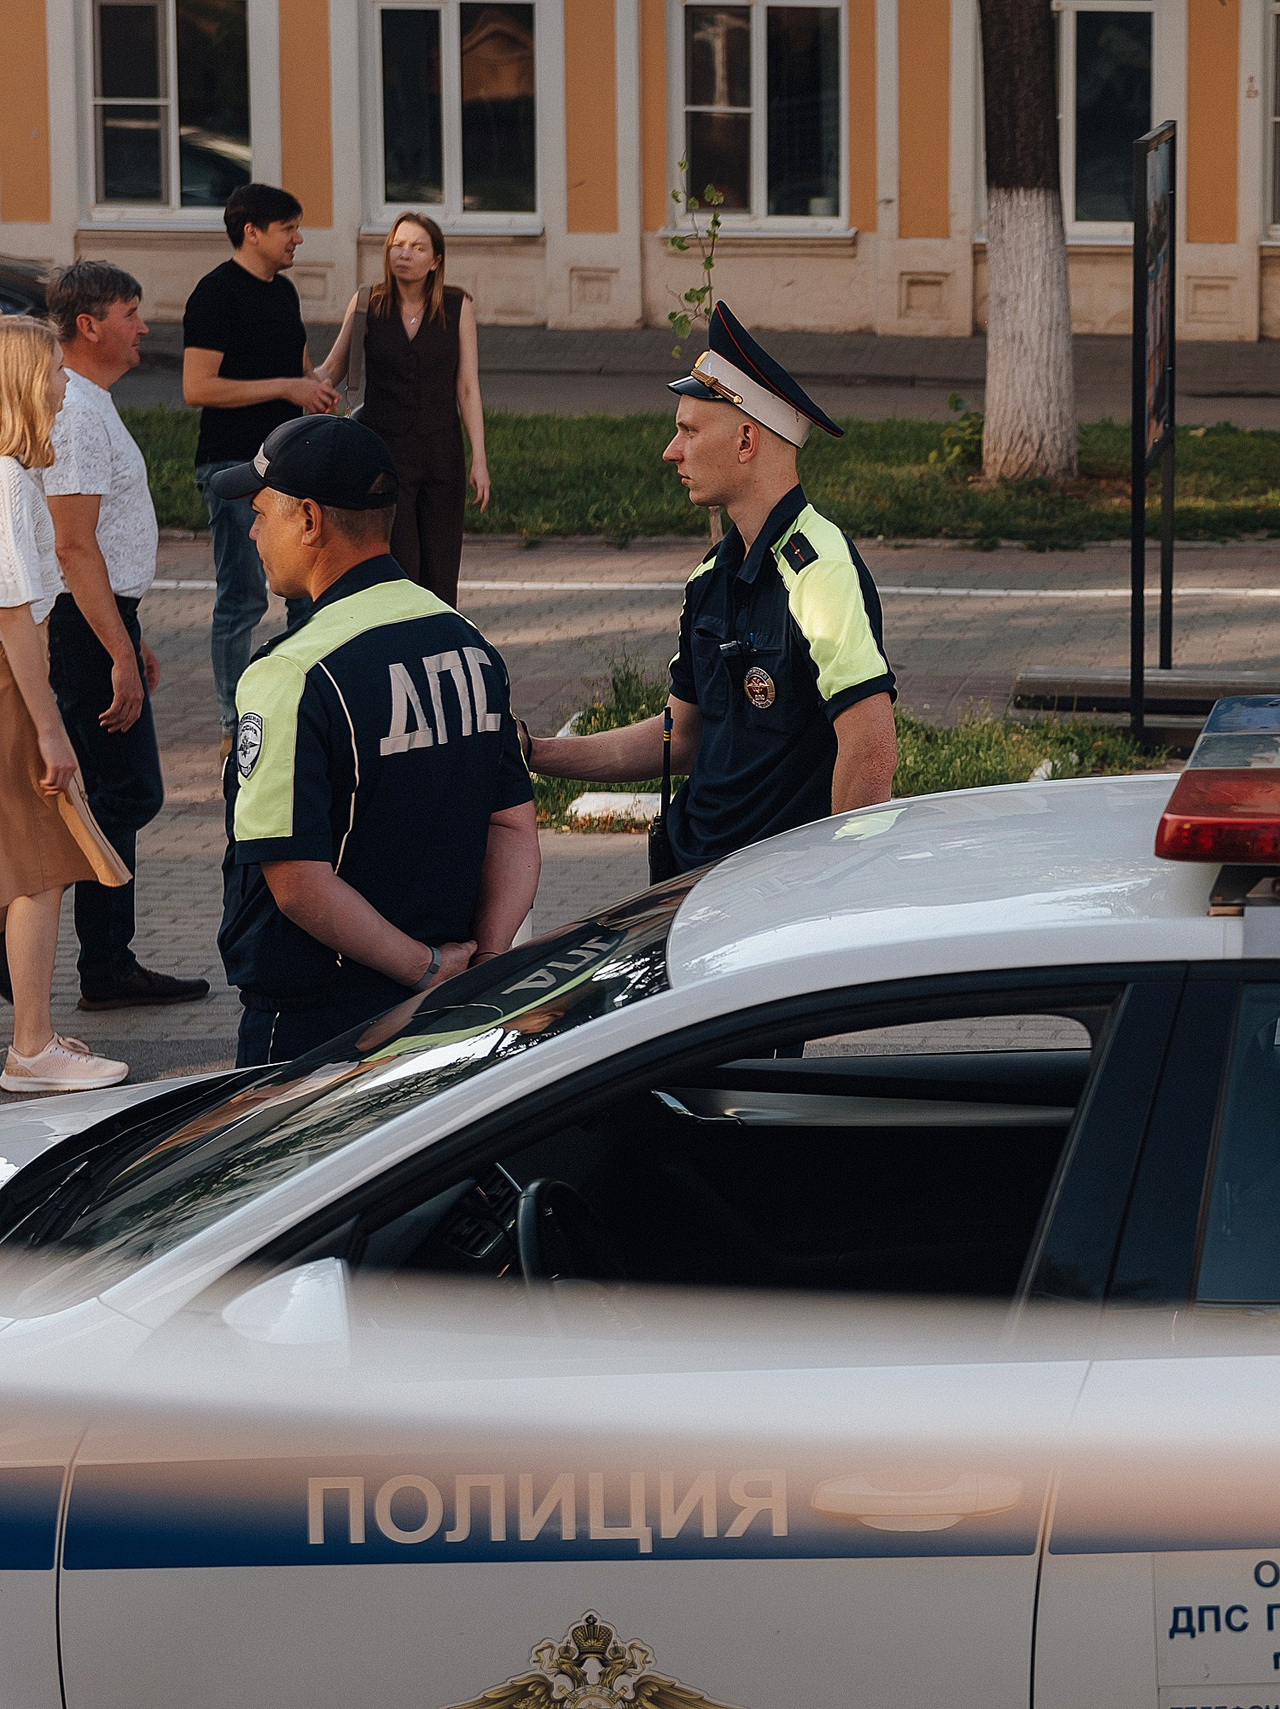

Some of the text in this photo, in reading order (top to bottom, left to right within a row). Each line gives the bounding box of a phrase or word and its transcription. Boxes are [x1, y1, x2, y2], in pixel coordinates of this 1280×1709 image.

[380, 647, 501, 756] ДПС
[307, 1469, 789, 1553] ПОЛИЦИЯ
[1168, 1604, 1250, 1640] ДПС
